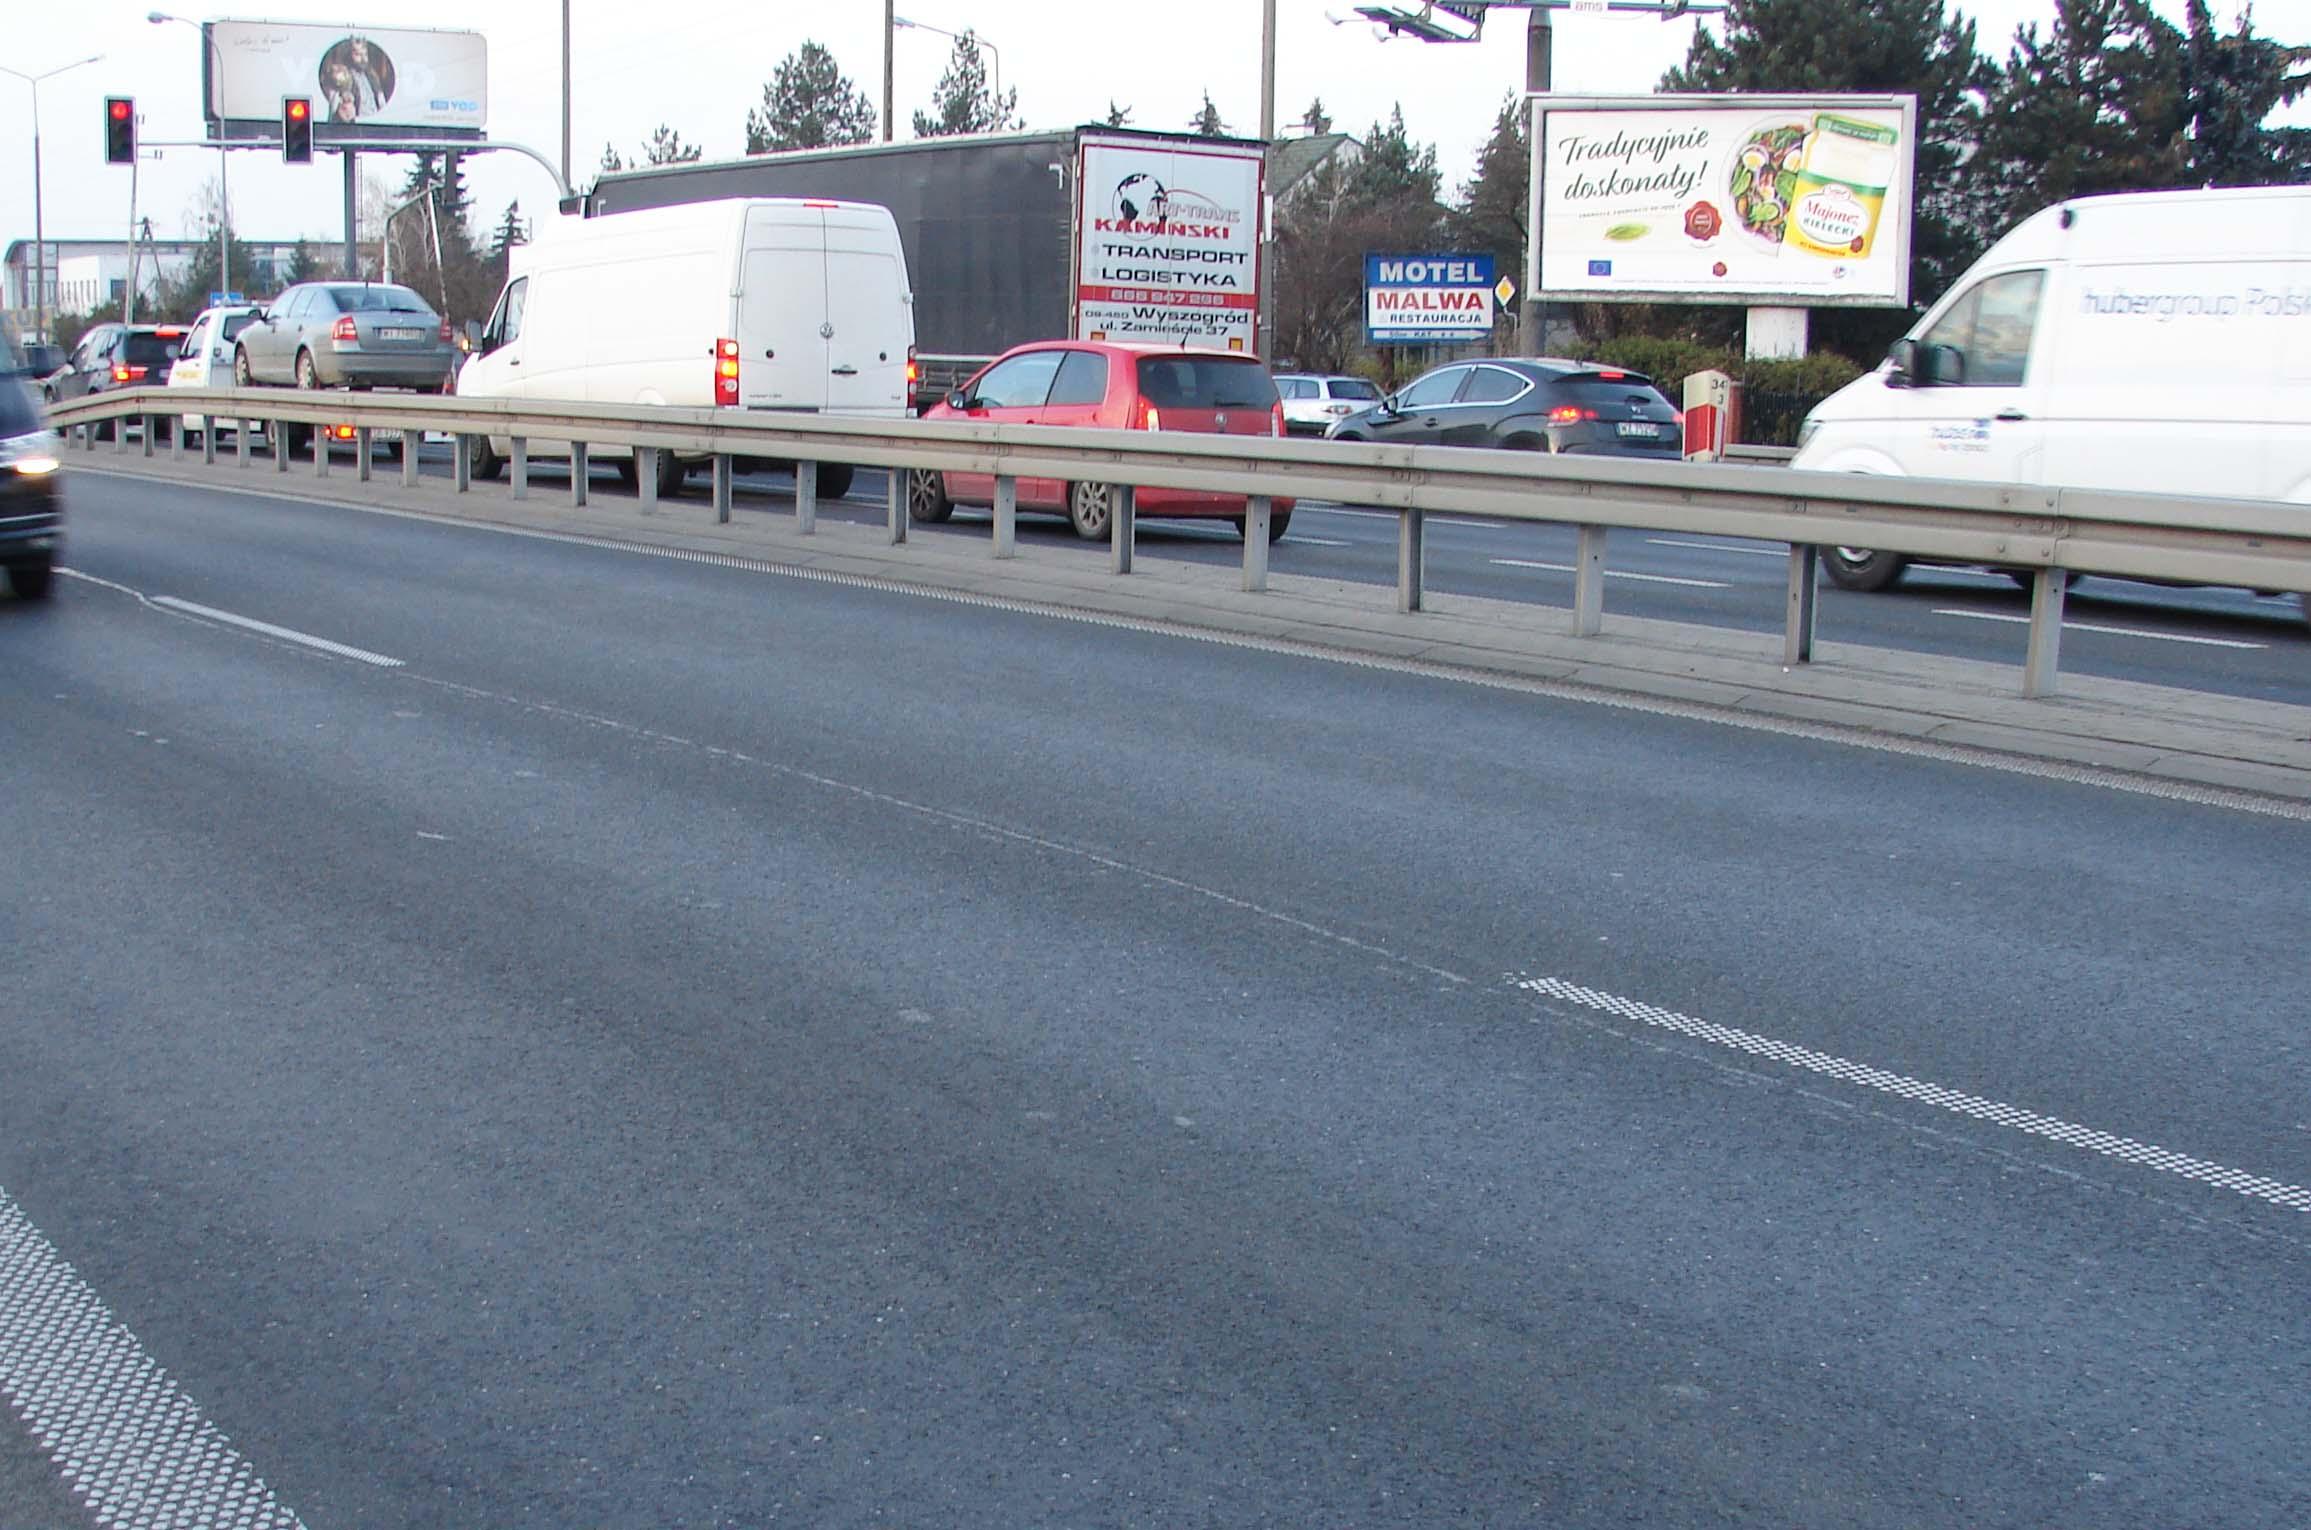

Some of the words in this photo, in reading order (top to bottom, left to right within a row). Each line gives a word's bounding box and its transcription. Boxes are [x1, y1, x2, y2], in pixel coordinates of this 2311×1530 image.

[1559, 127, 1709, 165] Tradycyjnie
[1806, 200, 1859, 225] Majonez
[1102, 244, 1248, 265] TRANSPORT
[1102, 267, 1237, 287] LOGISTYKA
[1379, 261, 1484, 282] MOTEL
[1376, 292, 1484, 310] MALWA
[1132, 306, 1249, 326] Wyszogród
[1390, 313, 1482, 324] RESTAURACJA
[1205, 325, 1228, 336] 37
